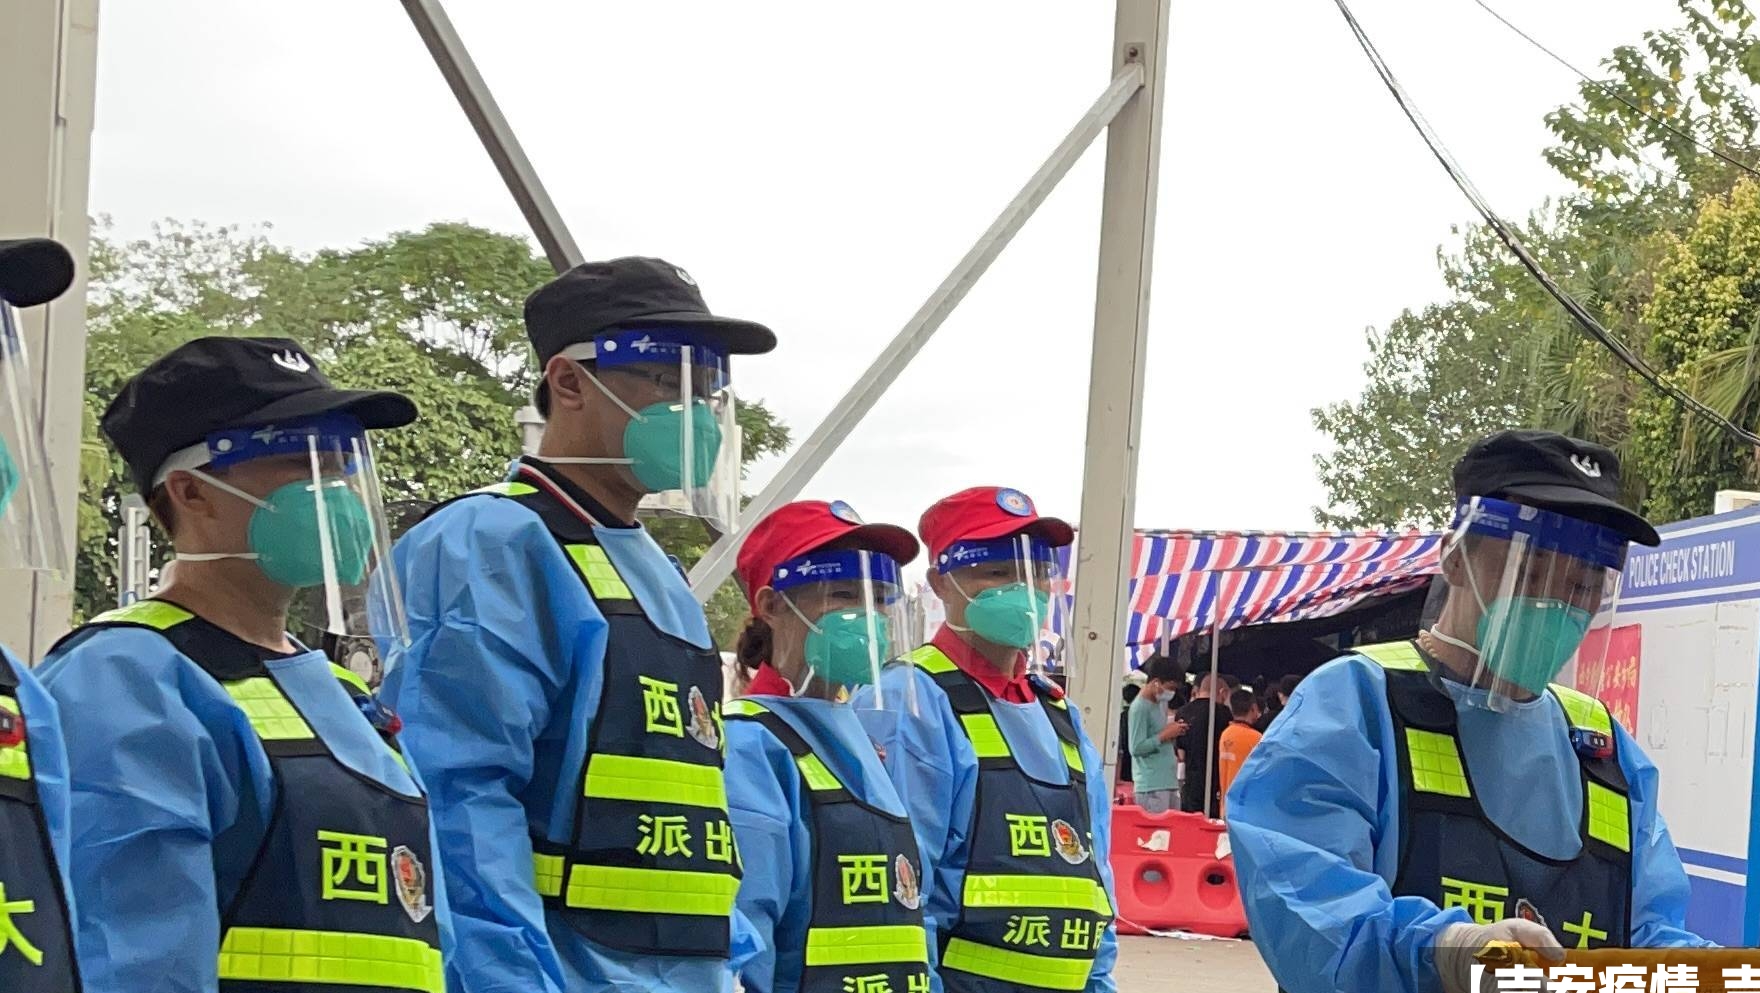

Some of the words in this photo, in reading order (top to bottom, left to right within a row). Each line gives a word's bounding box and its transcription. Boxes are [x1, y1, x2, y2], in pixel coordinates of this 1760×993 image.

[1628, 553, 1659, 588] POLICE
[1660, 546, 1690, 585] CHECK
[1690, 540, 1735, 580] STATION
[638, 675, 685, 738] 西
[1005, 813, 1051, 857] 西
[317, 830, 389, 904] 西
[838, 855, 889, 904] 西
